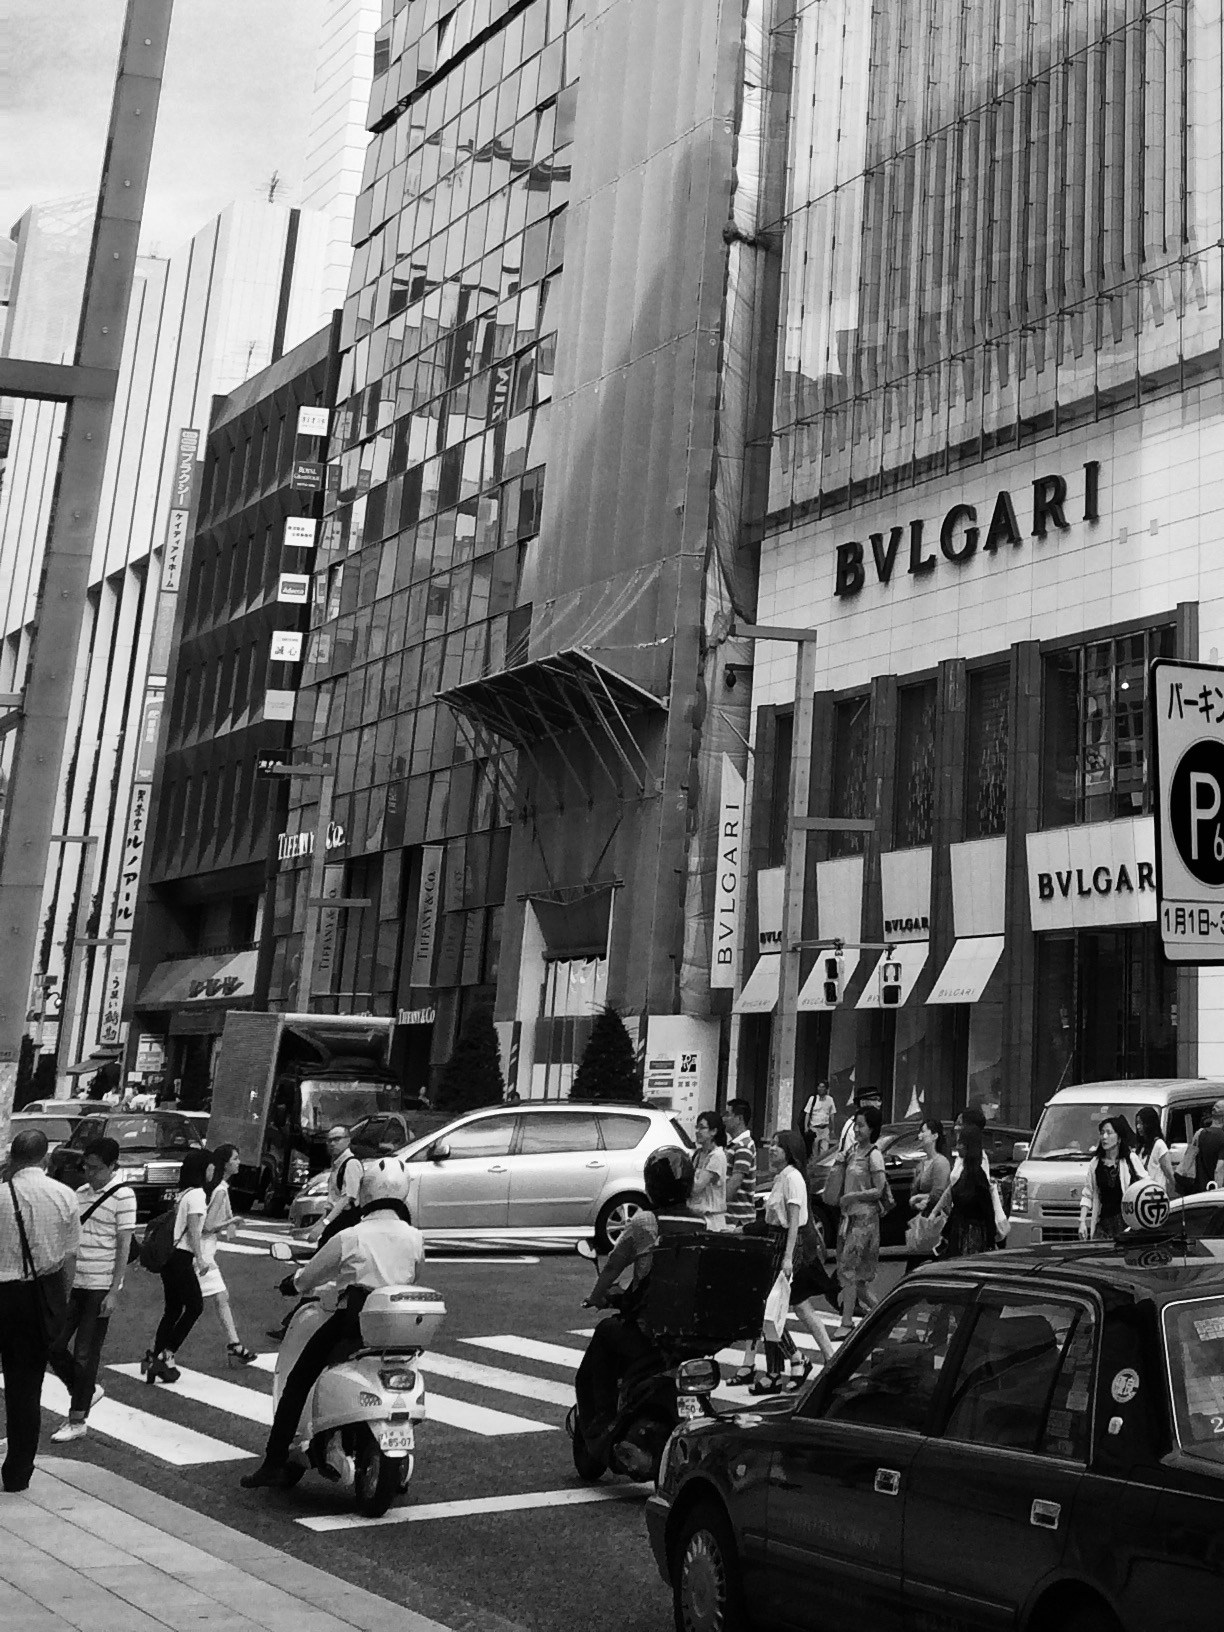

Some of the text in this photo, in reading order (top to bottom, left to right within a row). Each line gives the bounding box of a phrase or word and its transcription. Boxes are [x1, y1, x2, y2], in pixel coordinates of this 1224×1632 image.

[834, 461, 1101, 597] BVLGARI
[1189, 771, 1222, 860] P
[717, 803, 740, 966] BVLGARI
[1037, 861, 1157, 901] BVLGAR
